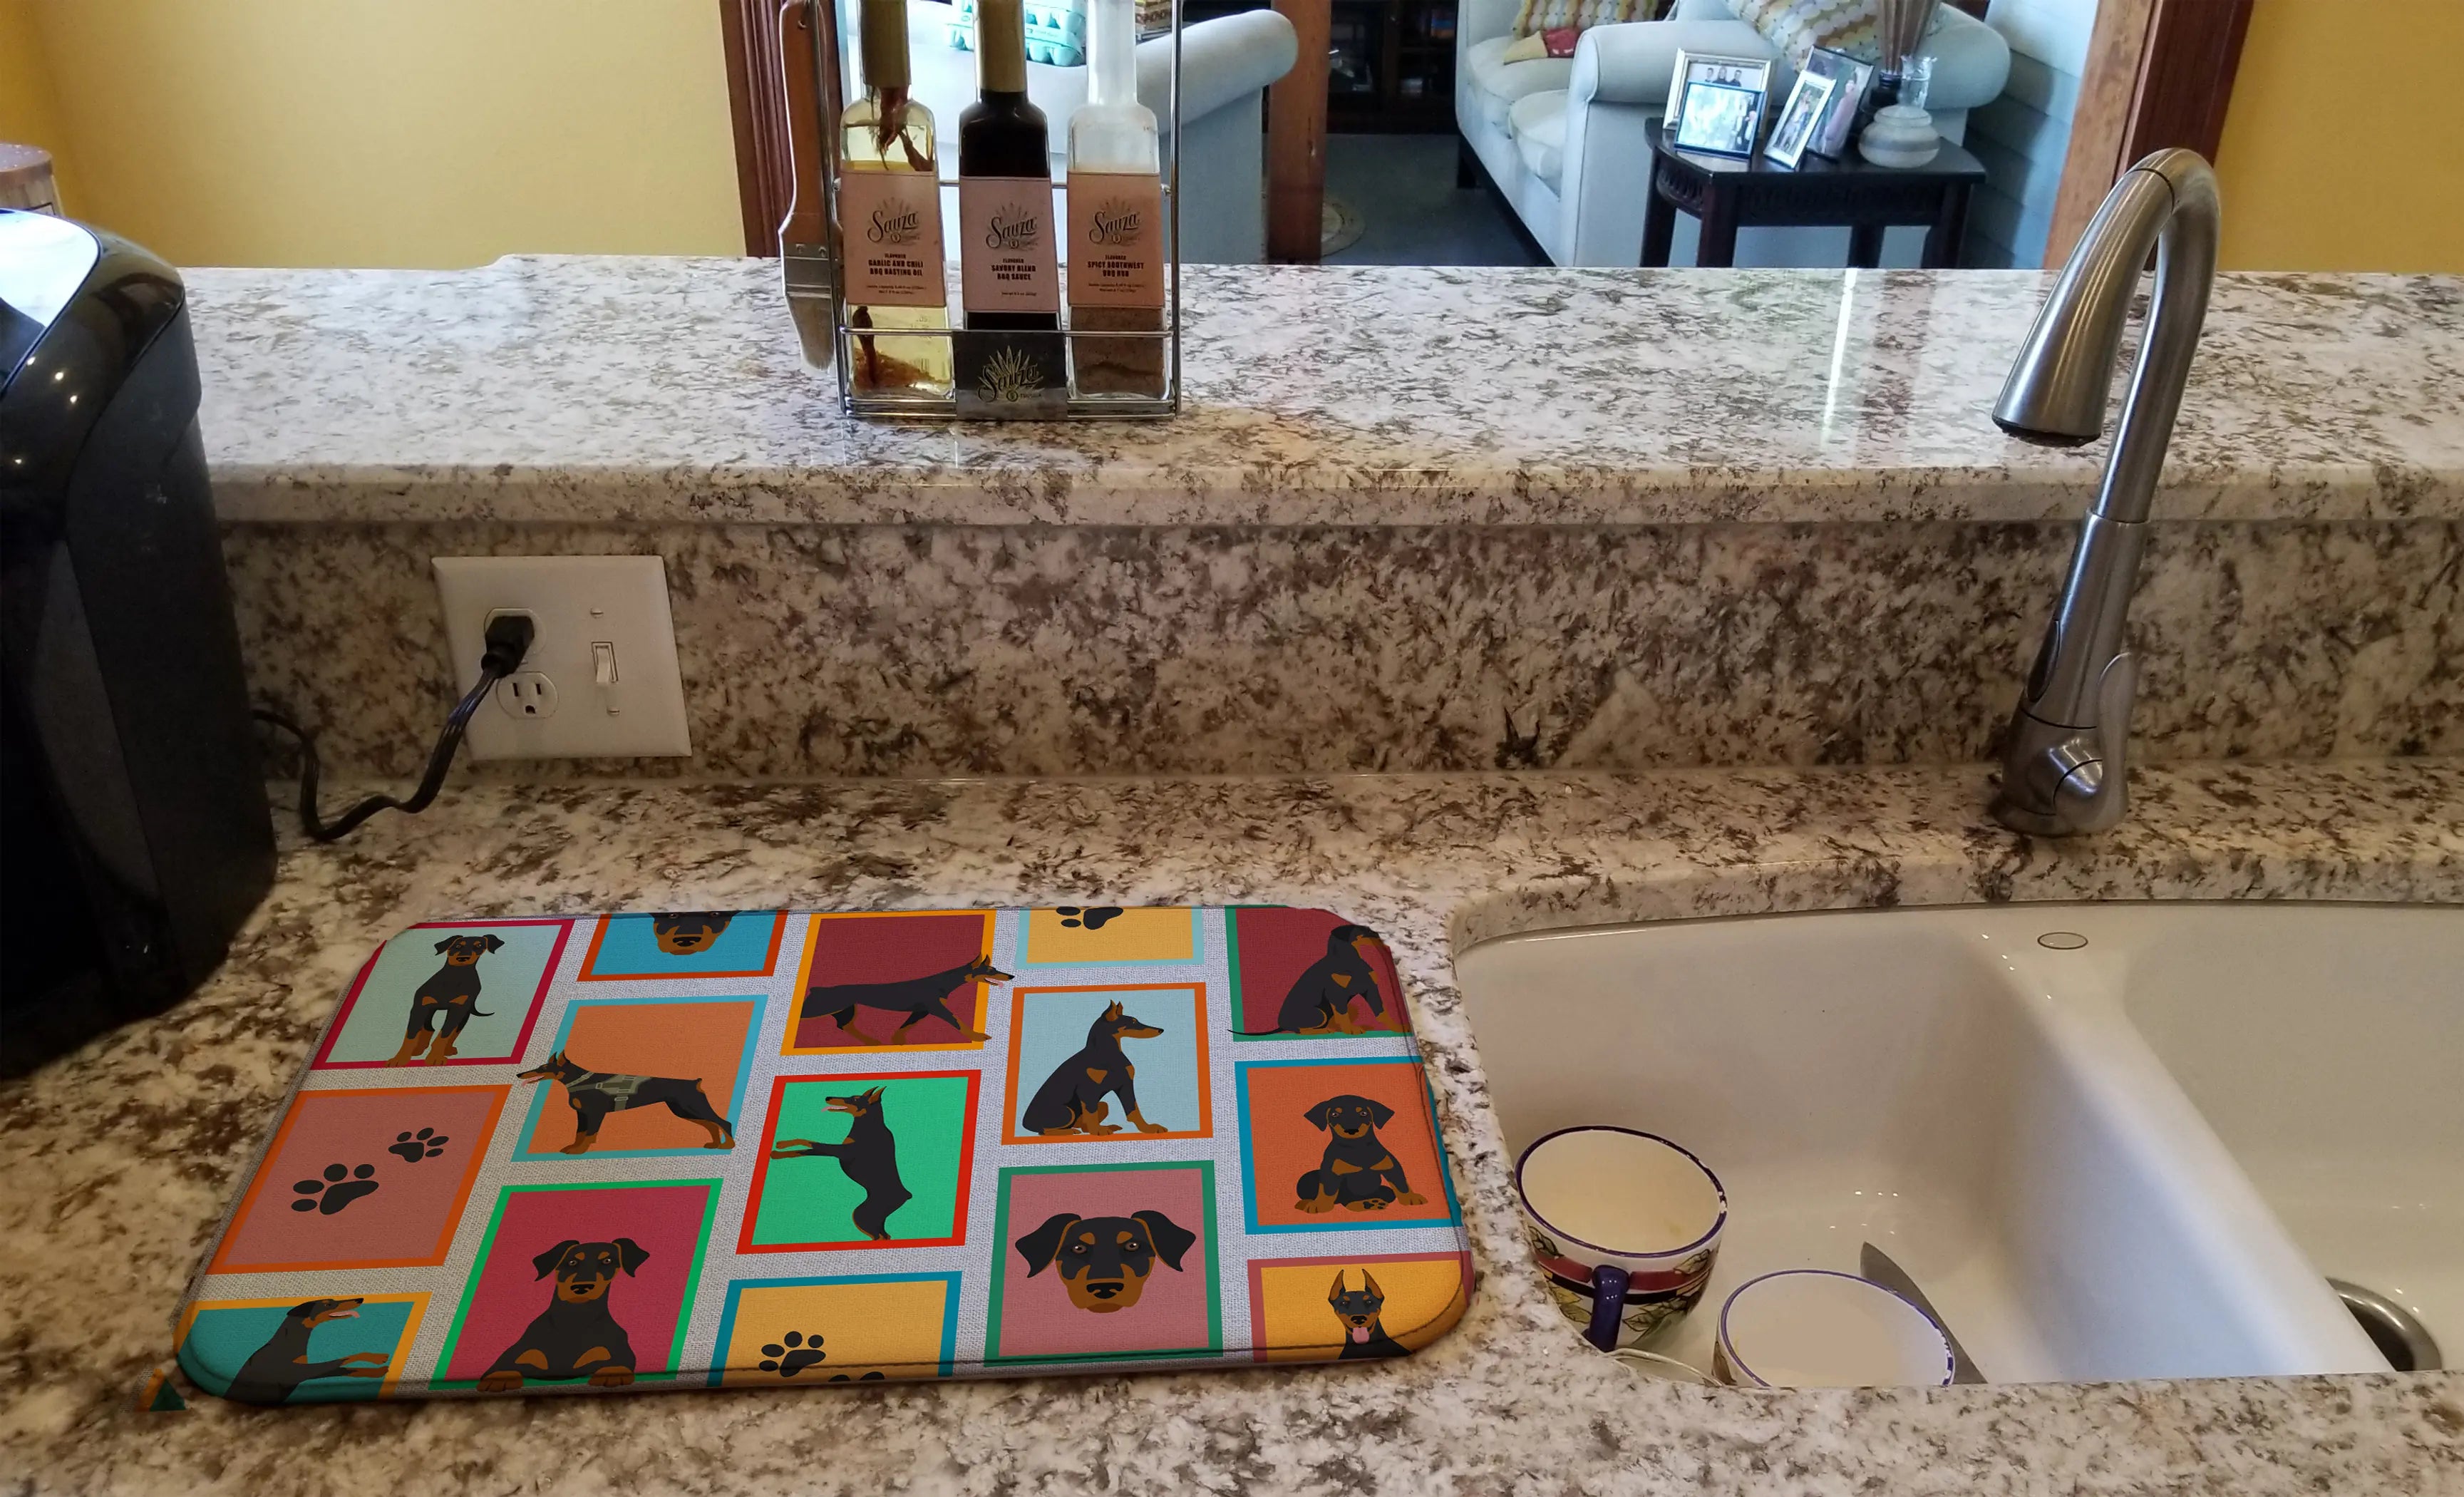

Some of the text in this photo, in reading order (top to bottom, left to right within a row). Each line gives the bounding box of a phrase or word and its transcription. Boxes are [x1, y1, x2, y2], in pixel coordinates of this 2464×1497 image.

[867, 210, 919, 243] Sauza
[986, 216, 1037, 249] Sauza
[1088, 211, 1140, 245] Sauza
[978, 364, 1041, 403] Sauza
